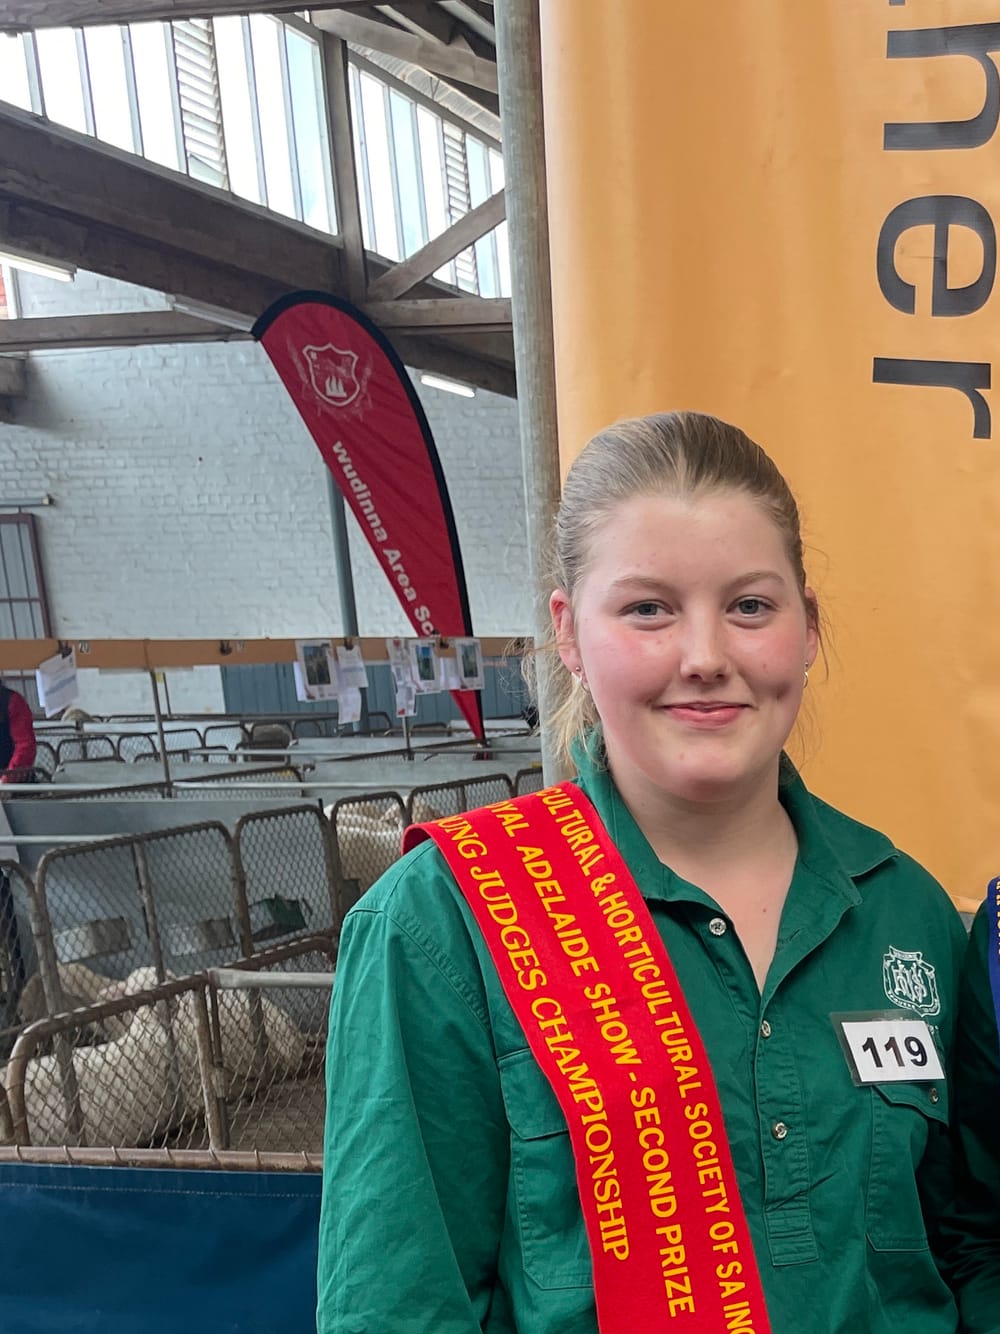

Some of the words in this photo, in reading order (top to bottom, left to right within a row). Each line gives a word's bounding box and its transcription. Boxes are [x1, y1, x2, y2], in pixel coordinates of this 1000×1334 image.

[382, 547, 417, 602] Area
[590, 872, 616, 897] &
[598, 891, 702, 1099] HORTICULTURAL
[437, 815, 487, 859] UNG
[470, 865, 547, 991] JUDGES
[531, 997, 630, 1261] CHAMPIONSHIP
[862, 1036, 928, 1068] 119
[516, 845, 600, 977] ADELAIDE
[584, 982, 643, 1065] SHOW
[630, 1086, 678, 1219] SECOND
[655, 1223, 696, 1318] PRIZE
[684, 1101, 730, 1213] SOCIETY
[708, 1220, 739, 1255] OF
[715, 1260, 746, 1300] SA
